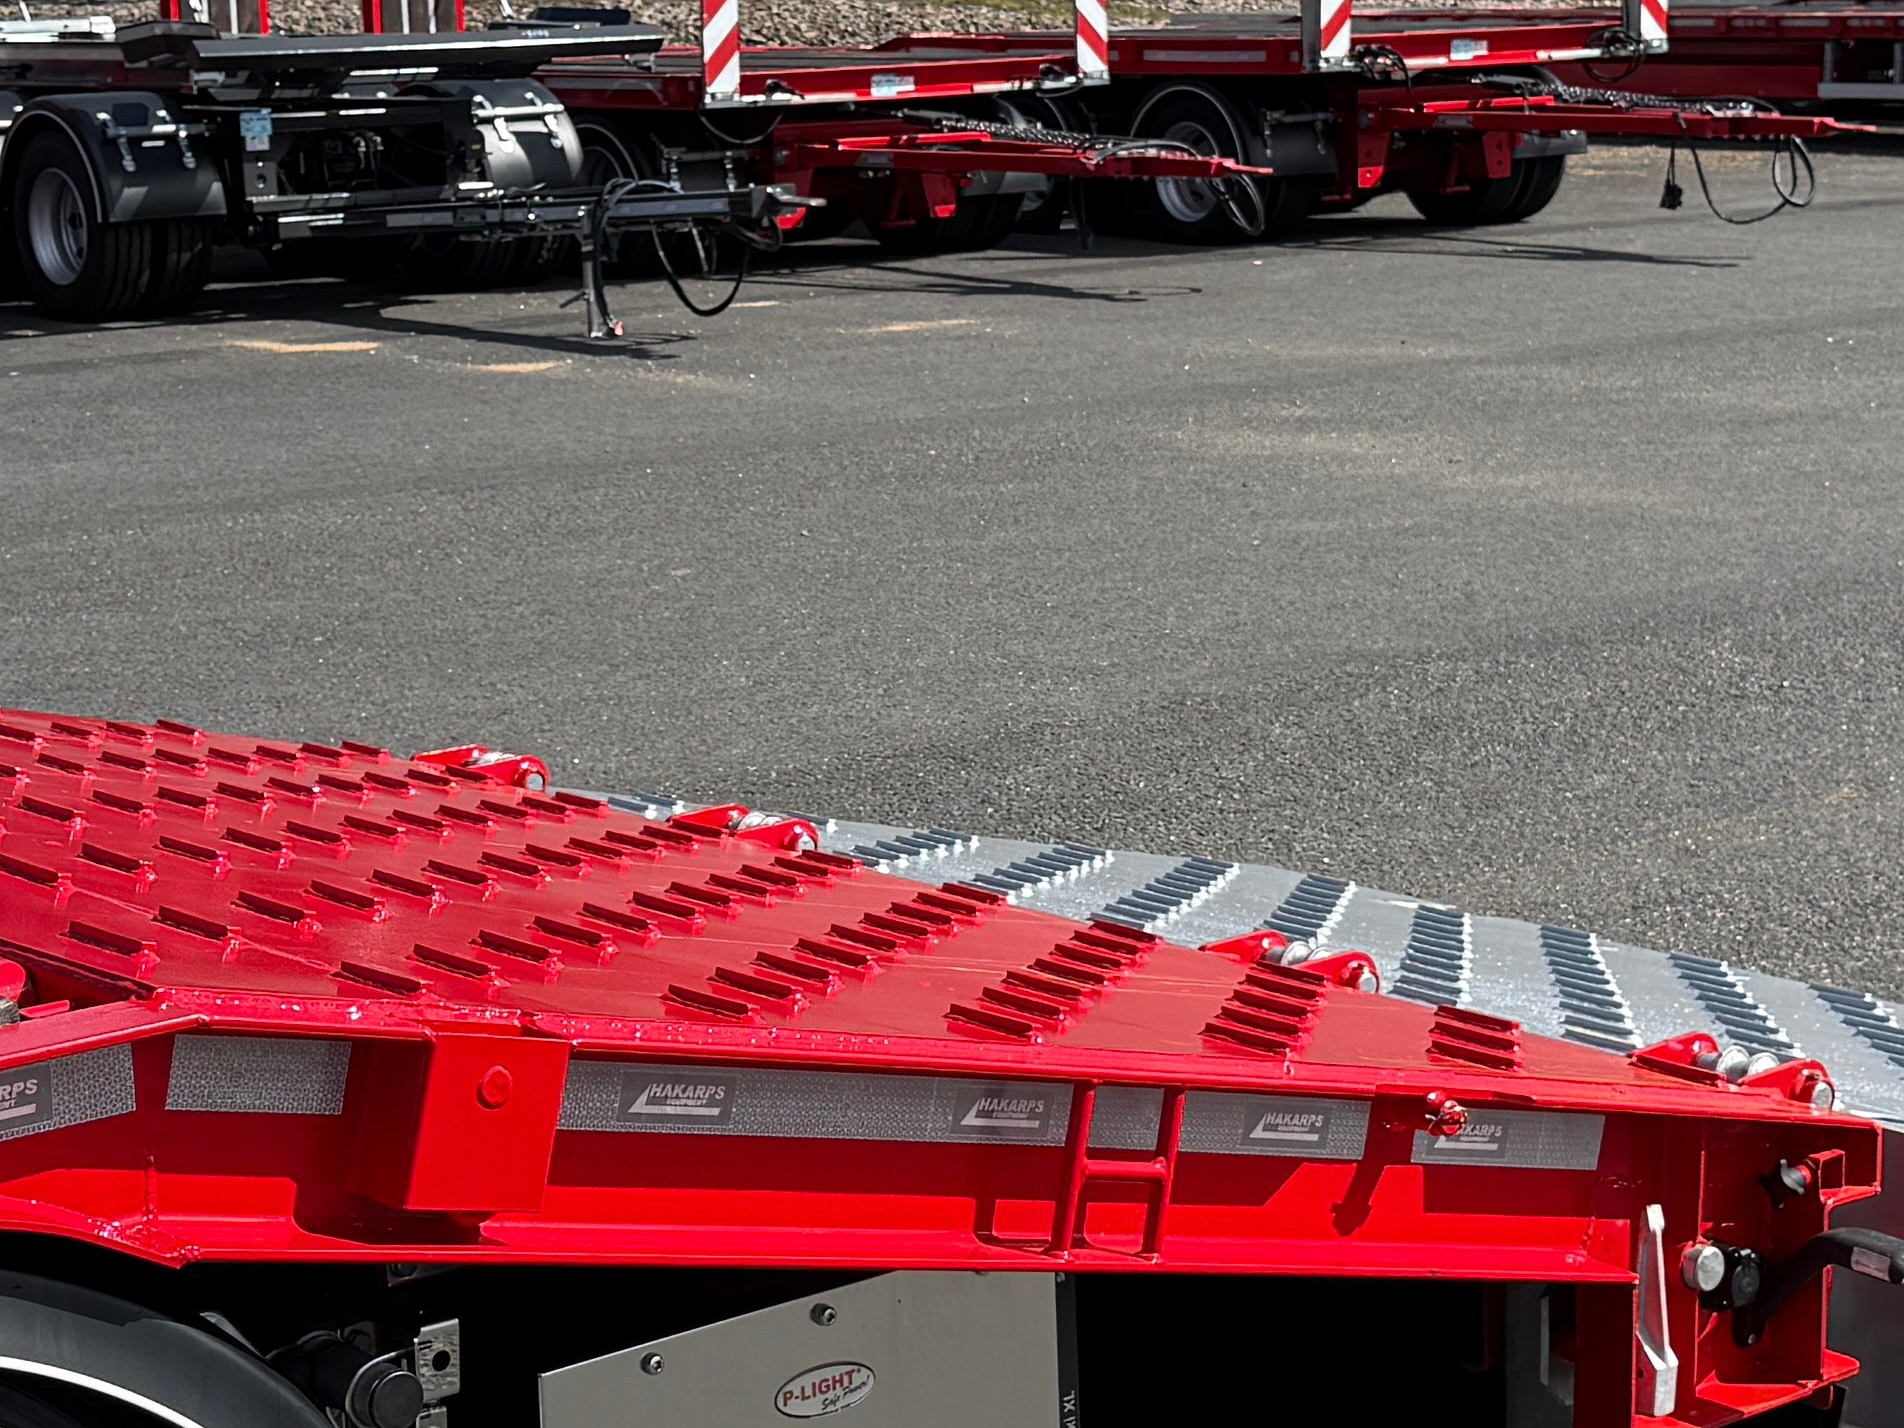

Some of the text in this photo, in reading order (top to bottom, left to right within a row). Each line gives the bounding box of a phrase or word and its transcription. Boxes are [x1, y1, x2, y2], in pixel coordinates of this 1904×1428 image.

[649, 1083, 726, 1100] HAKARPS
[978, 1097, 1045, 1113] HAKARPS
[1265, 1112, 1324, 1127] HAKARPS
[1063, 1390, 1076, 1412] XL
